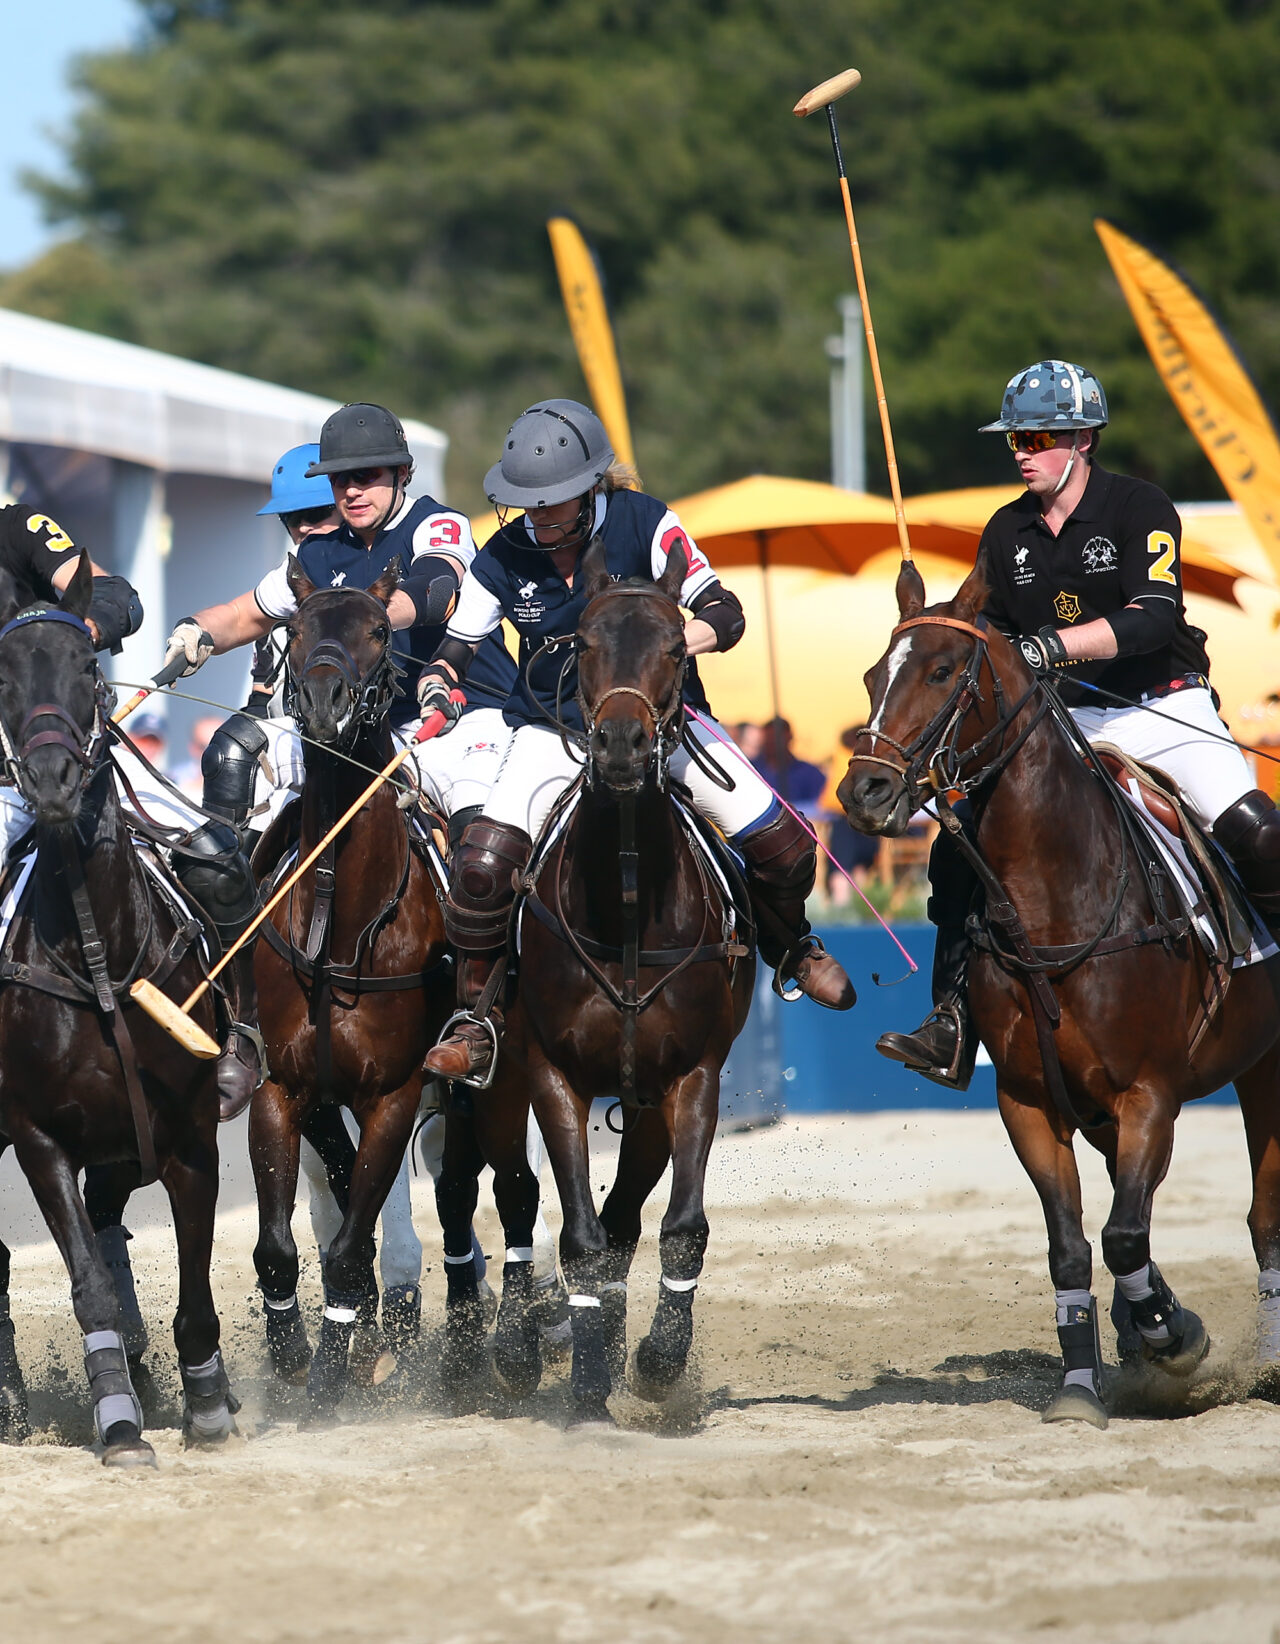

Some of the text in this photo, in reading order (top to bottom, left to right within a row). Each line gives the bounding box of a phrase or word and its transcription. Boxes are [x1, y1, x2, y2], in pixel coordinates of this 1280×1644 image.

[26, 513, 75, 552] 3
[429, 518, 461, 547] 3
[659, 525, 706, 579] 2
[1147, 530, 1177, 586] 2
